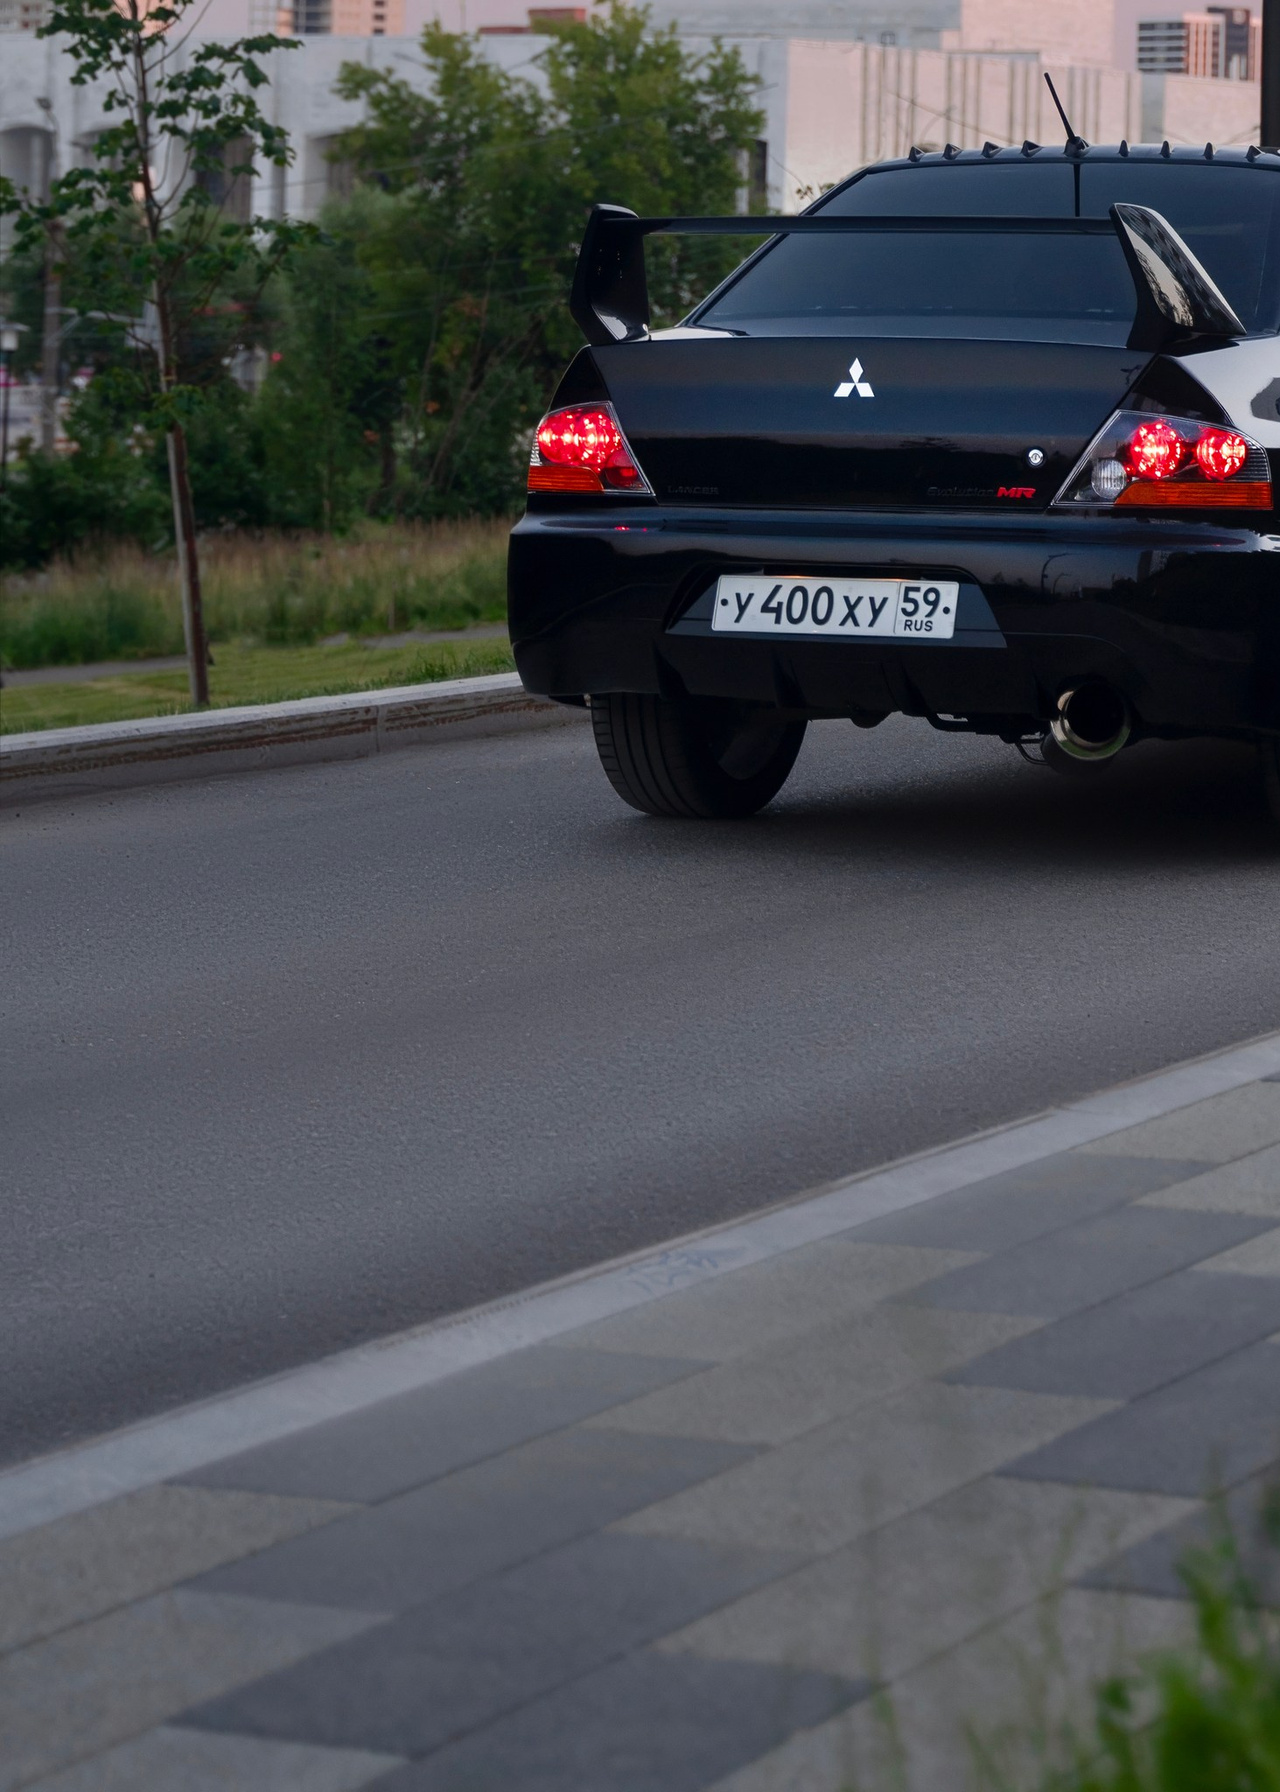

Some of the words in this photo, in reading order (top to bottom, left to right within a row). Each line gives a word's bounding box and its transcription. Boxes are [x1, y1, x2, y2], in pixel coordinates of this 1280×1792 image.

[996, 485, 1037, 499] MR
[900, 586, 941, 619] 59
[903, 619, 934, 632] RUS
